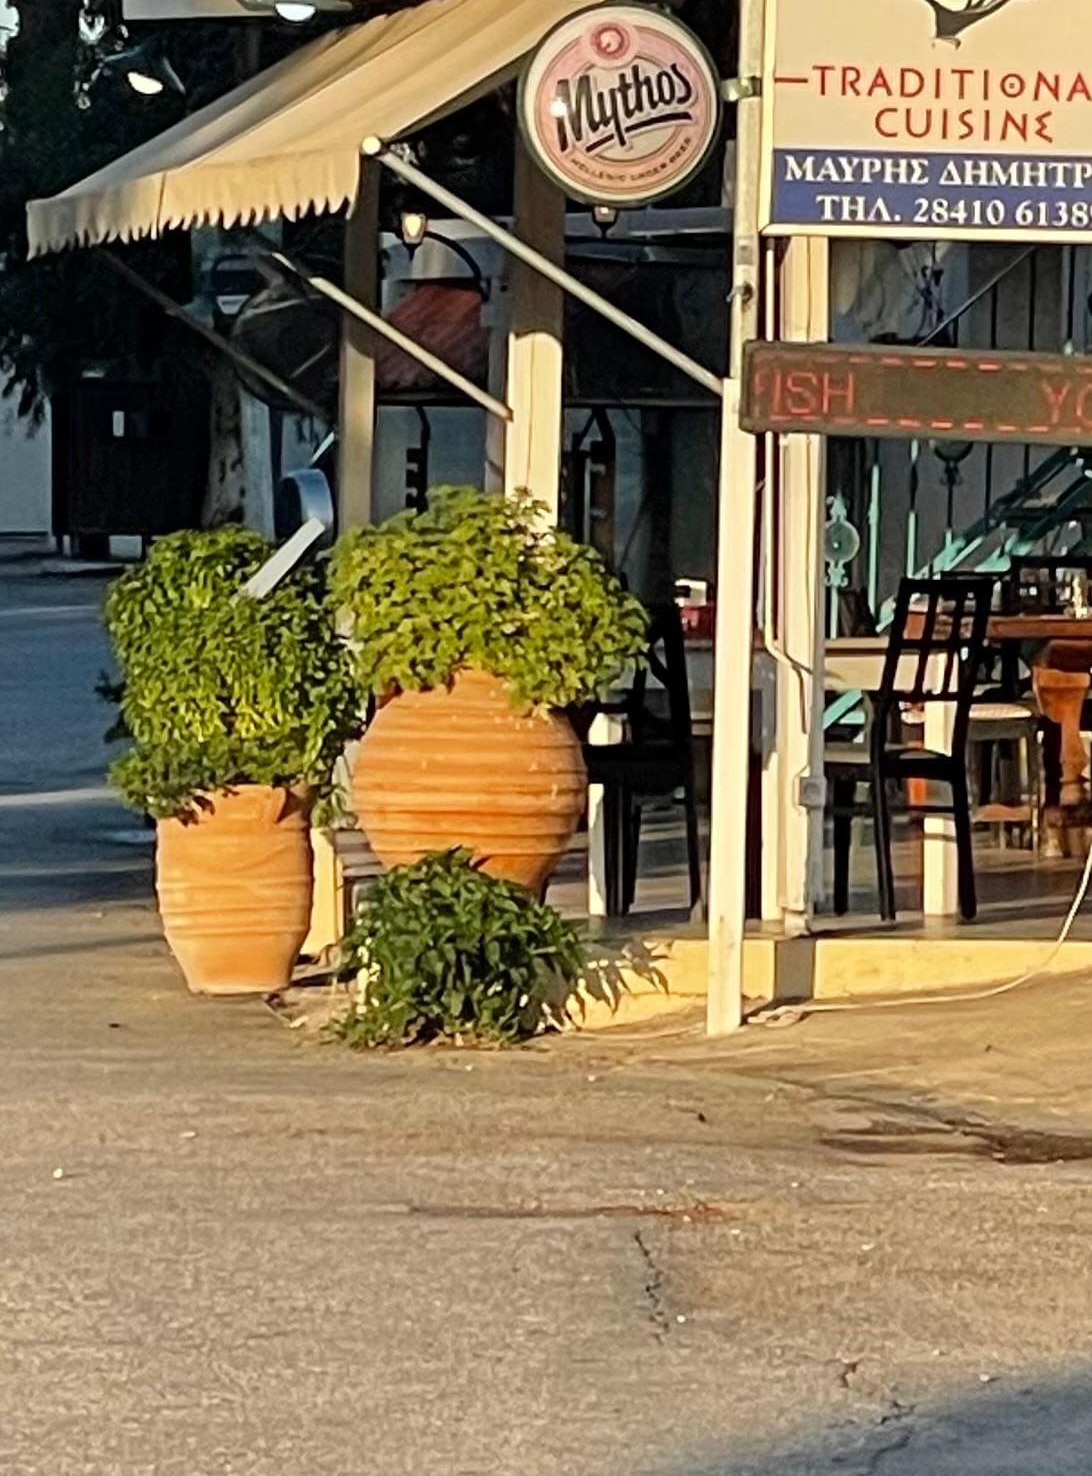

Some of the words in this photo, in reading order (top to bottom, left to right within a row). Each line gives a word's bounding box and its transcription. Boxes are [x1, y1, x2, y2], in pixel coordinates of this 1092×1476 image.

[555, 63, 693, 152] Mythos
[875, 107, 1054, 143] CUISINE
[784, 155, 929, 185] ΜΑΥΡΗΣ
[816, 195, 901, 222] ΤΗΛ.
[913, 197, 1005, 225] 28410
